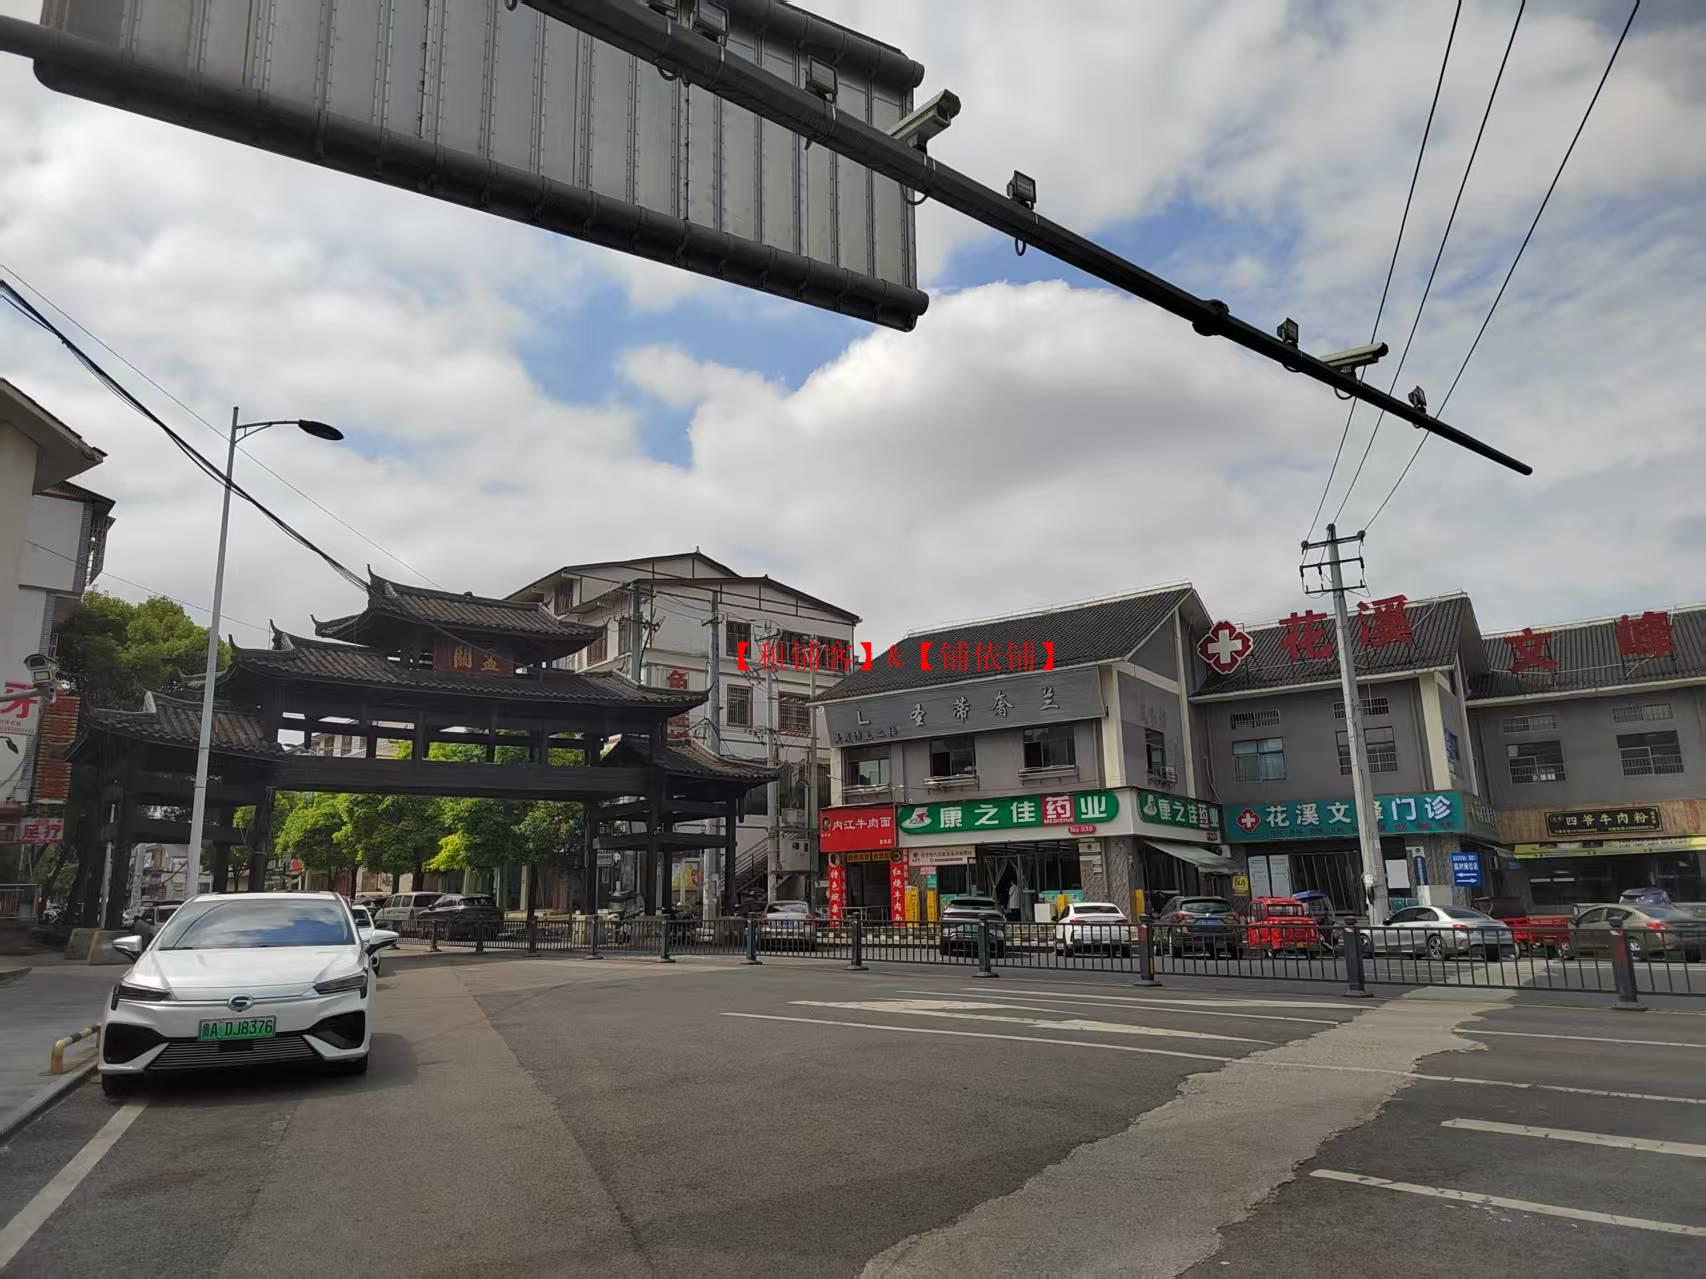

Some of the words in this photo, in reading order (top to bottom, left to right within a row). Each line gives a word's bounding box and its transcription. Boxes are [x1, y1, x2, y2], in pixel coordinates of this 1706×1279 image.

[832, 816, 892, 832] 内江牛肉面
[939, 795, 1108, 829] 康之佳药业
[1158, 798, 1220, 829] 康之佳药业
[23, 823, 63, 840] 足疗
